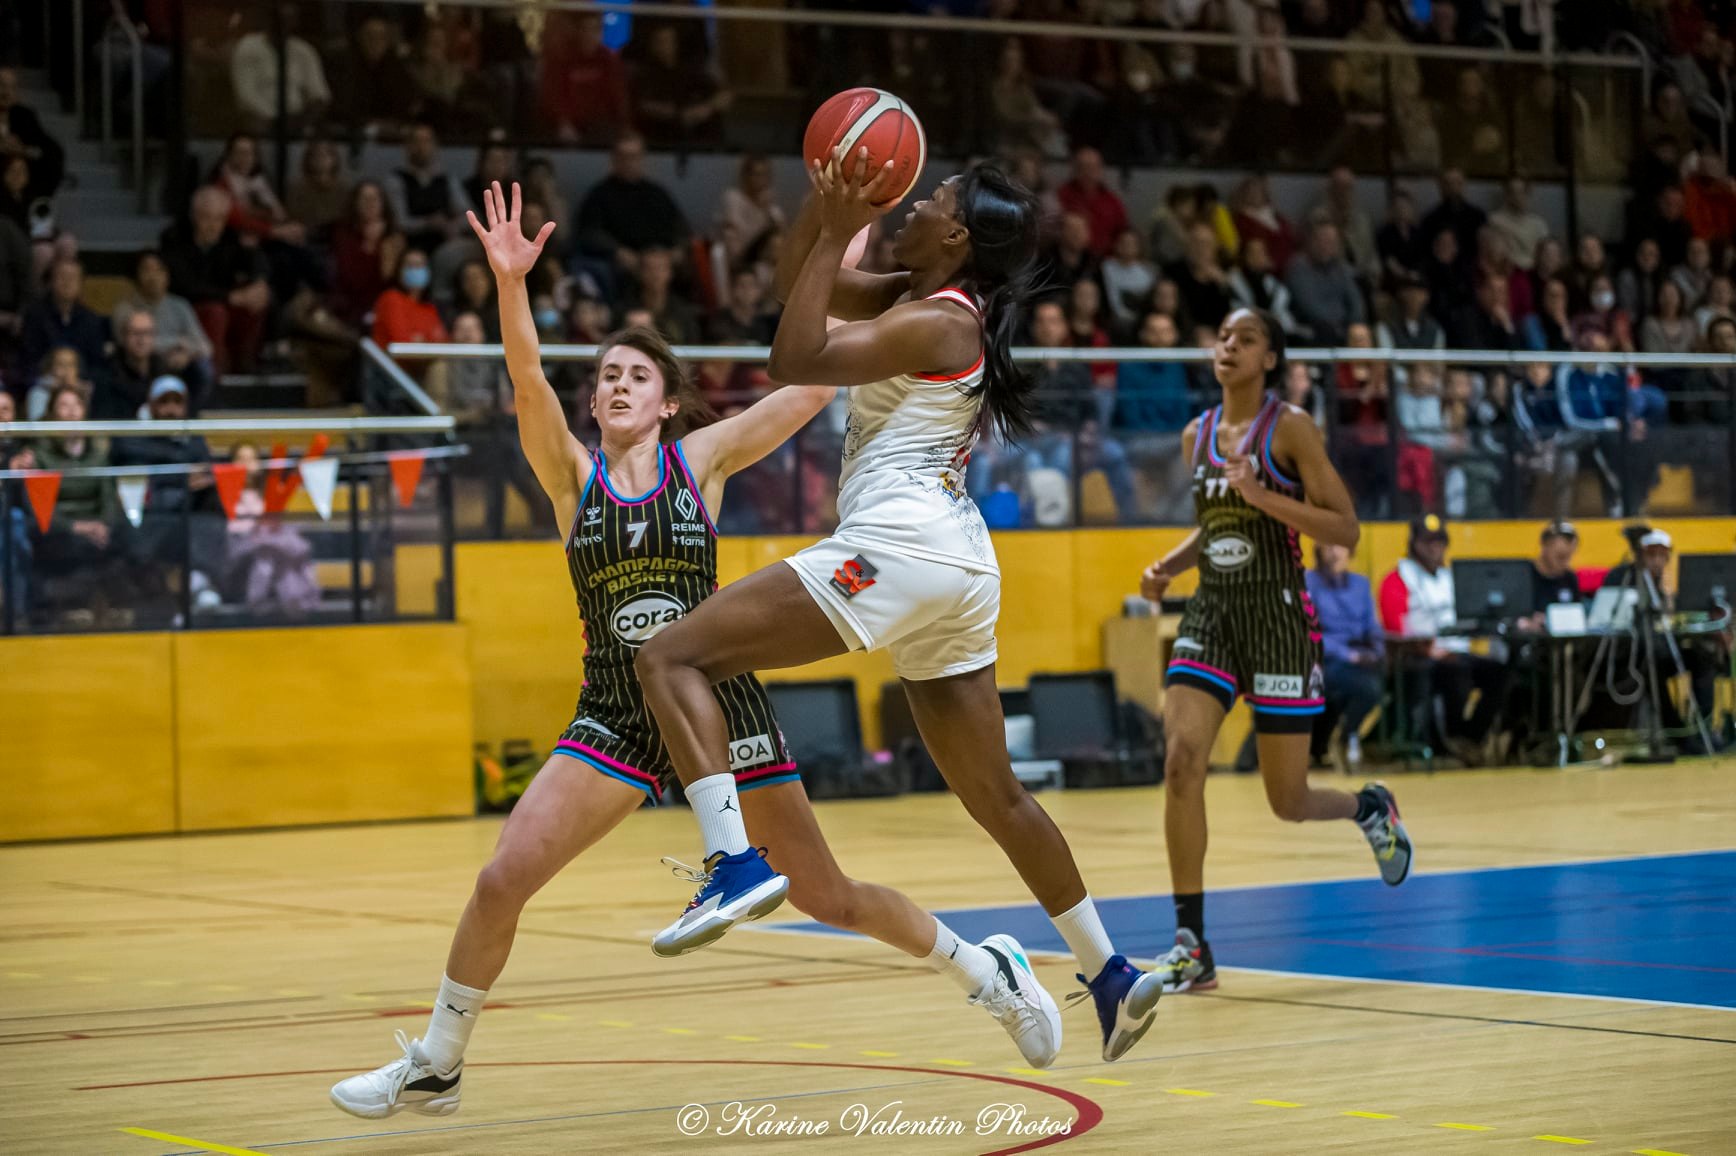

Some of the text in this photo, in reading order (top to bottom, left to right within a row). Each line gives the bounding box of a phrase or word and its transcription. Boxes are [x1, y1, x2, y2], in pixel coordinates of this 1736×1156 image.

[1205, 478, 1229, 499] 77
[627, 521, 649, 548] 7
[671, 523, 705, 532] REIMS
[607, 571, 676, 594] BASKET
[616, 608, 678, 632] cora
[1269, 680, 1299, 692] JOA
[728, 741, 769, 764] JOA
